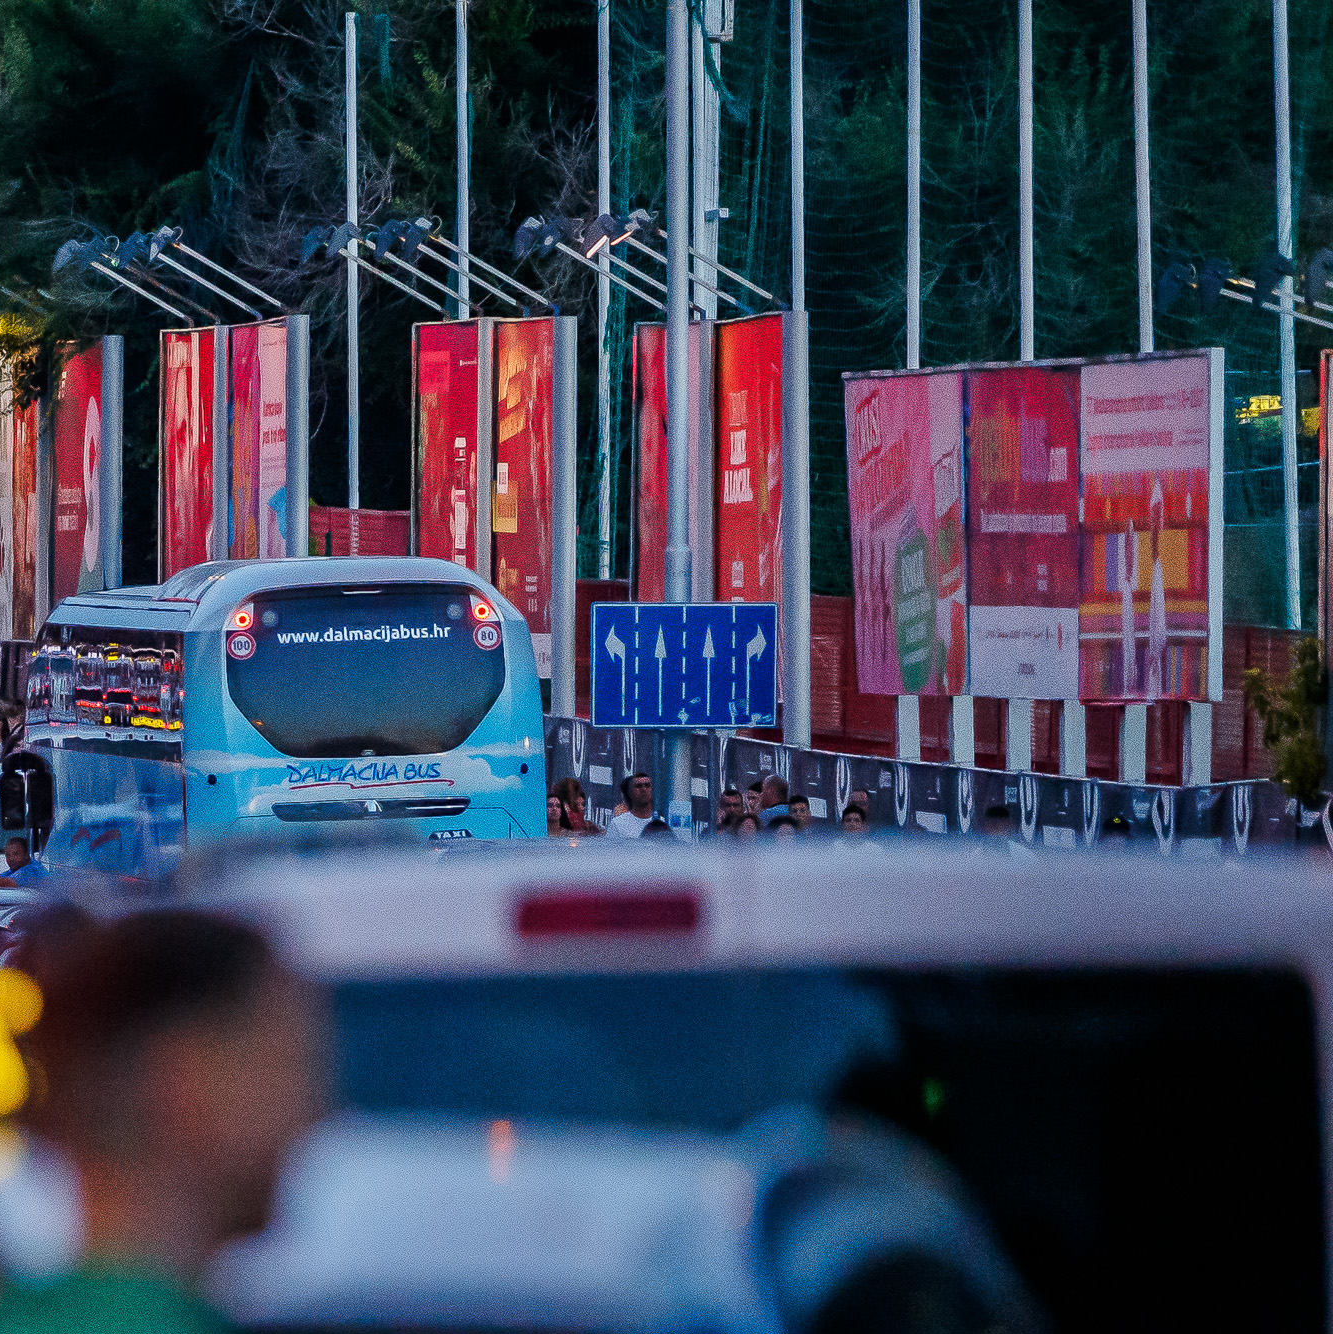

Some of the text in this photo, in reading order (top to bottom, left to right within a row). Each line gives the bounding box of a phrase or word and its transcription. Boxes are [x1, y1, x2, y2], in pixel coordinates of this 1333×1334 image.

[277, 624, 451, 646] www.dalmacijabus.hr
[481, 631, 494, 641] 80
[232, 640, 251, 651] 100
[287, 762, 441, 783] DALMACIJA BUS
[436, 830, 466, 839] TAXI
